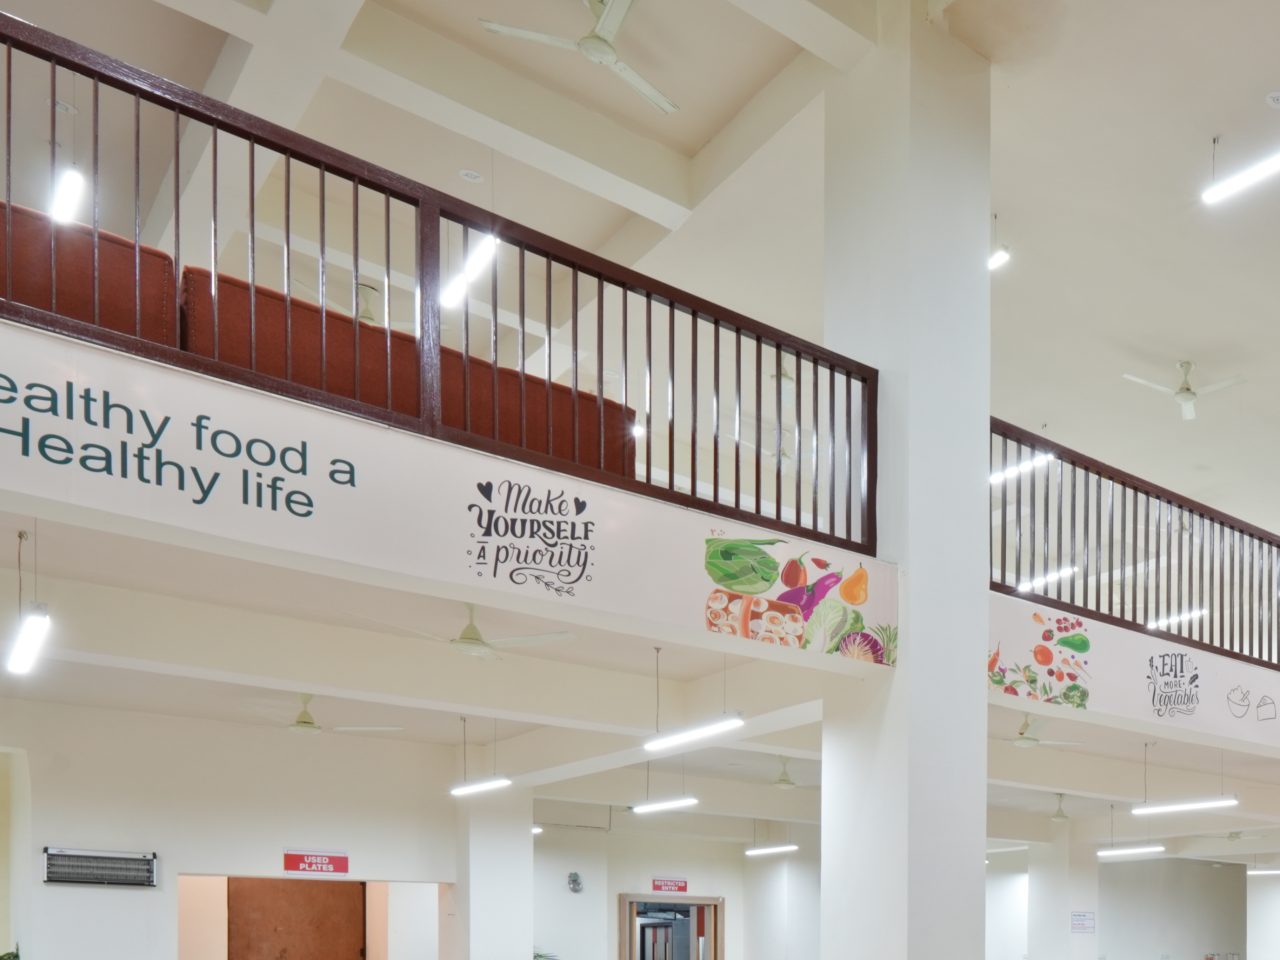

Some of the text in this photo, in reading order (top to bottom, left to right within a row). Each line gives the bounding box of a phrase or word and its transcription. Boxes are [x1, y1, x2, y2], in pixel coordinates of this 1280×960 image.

[0, 416, 314, 518] Healthy life
[191, 415, 308, 475] food
[329, 458, 356, 488] a
[498, 480, 570, 516] Make
[468, 503, 595, 547] YOURSELF
[493, 543, 589, 585] priority
[1159, 653, 1187, 678] EAT
[1148, 682, 1200, 717] Vegetables
[1164, 680, 1182, 689] MORE
[299, 863, 334, 872] PLATES
